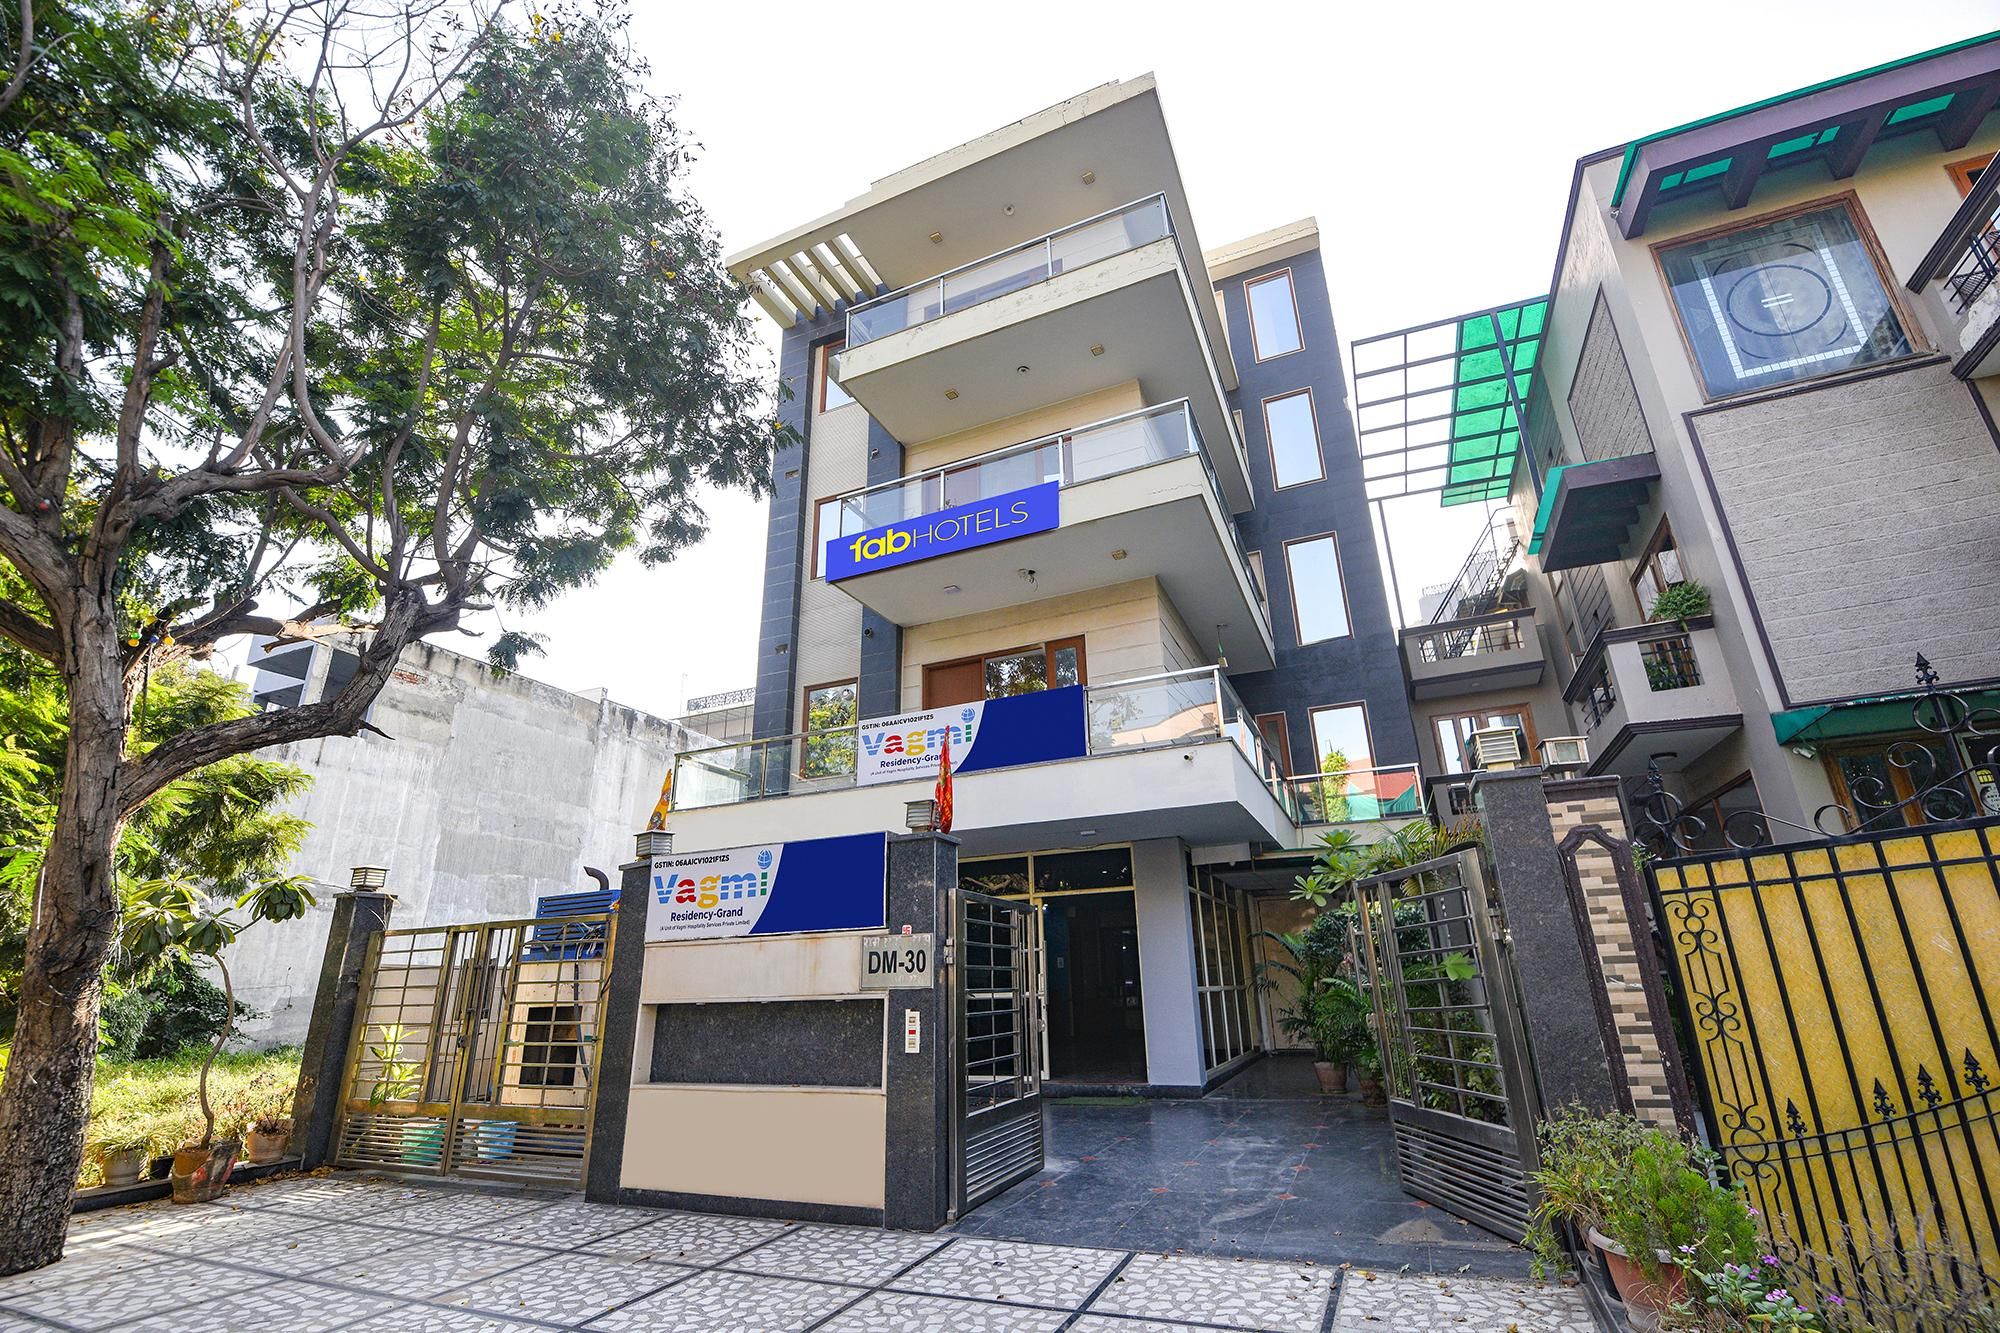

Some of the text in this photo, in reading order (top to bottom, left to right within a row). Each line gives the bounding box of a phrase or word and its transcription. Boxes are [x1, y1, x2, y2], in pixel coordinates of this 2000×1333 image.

[849, 501, 1029, 563] fabHOTELS
[880, 754, 941, 768] Residency-Gra
[654, 861, 674, 869] GSTIN:
[670, 906, 744, 922] Residency-Grand
[868, 949, 927, 974] DM-30
